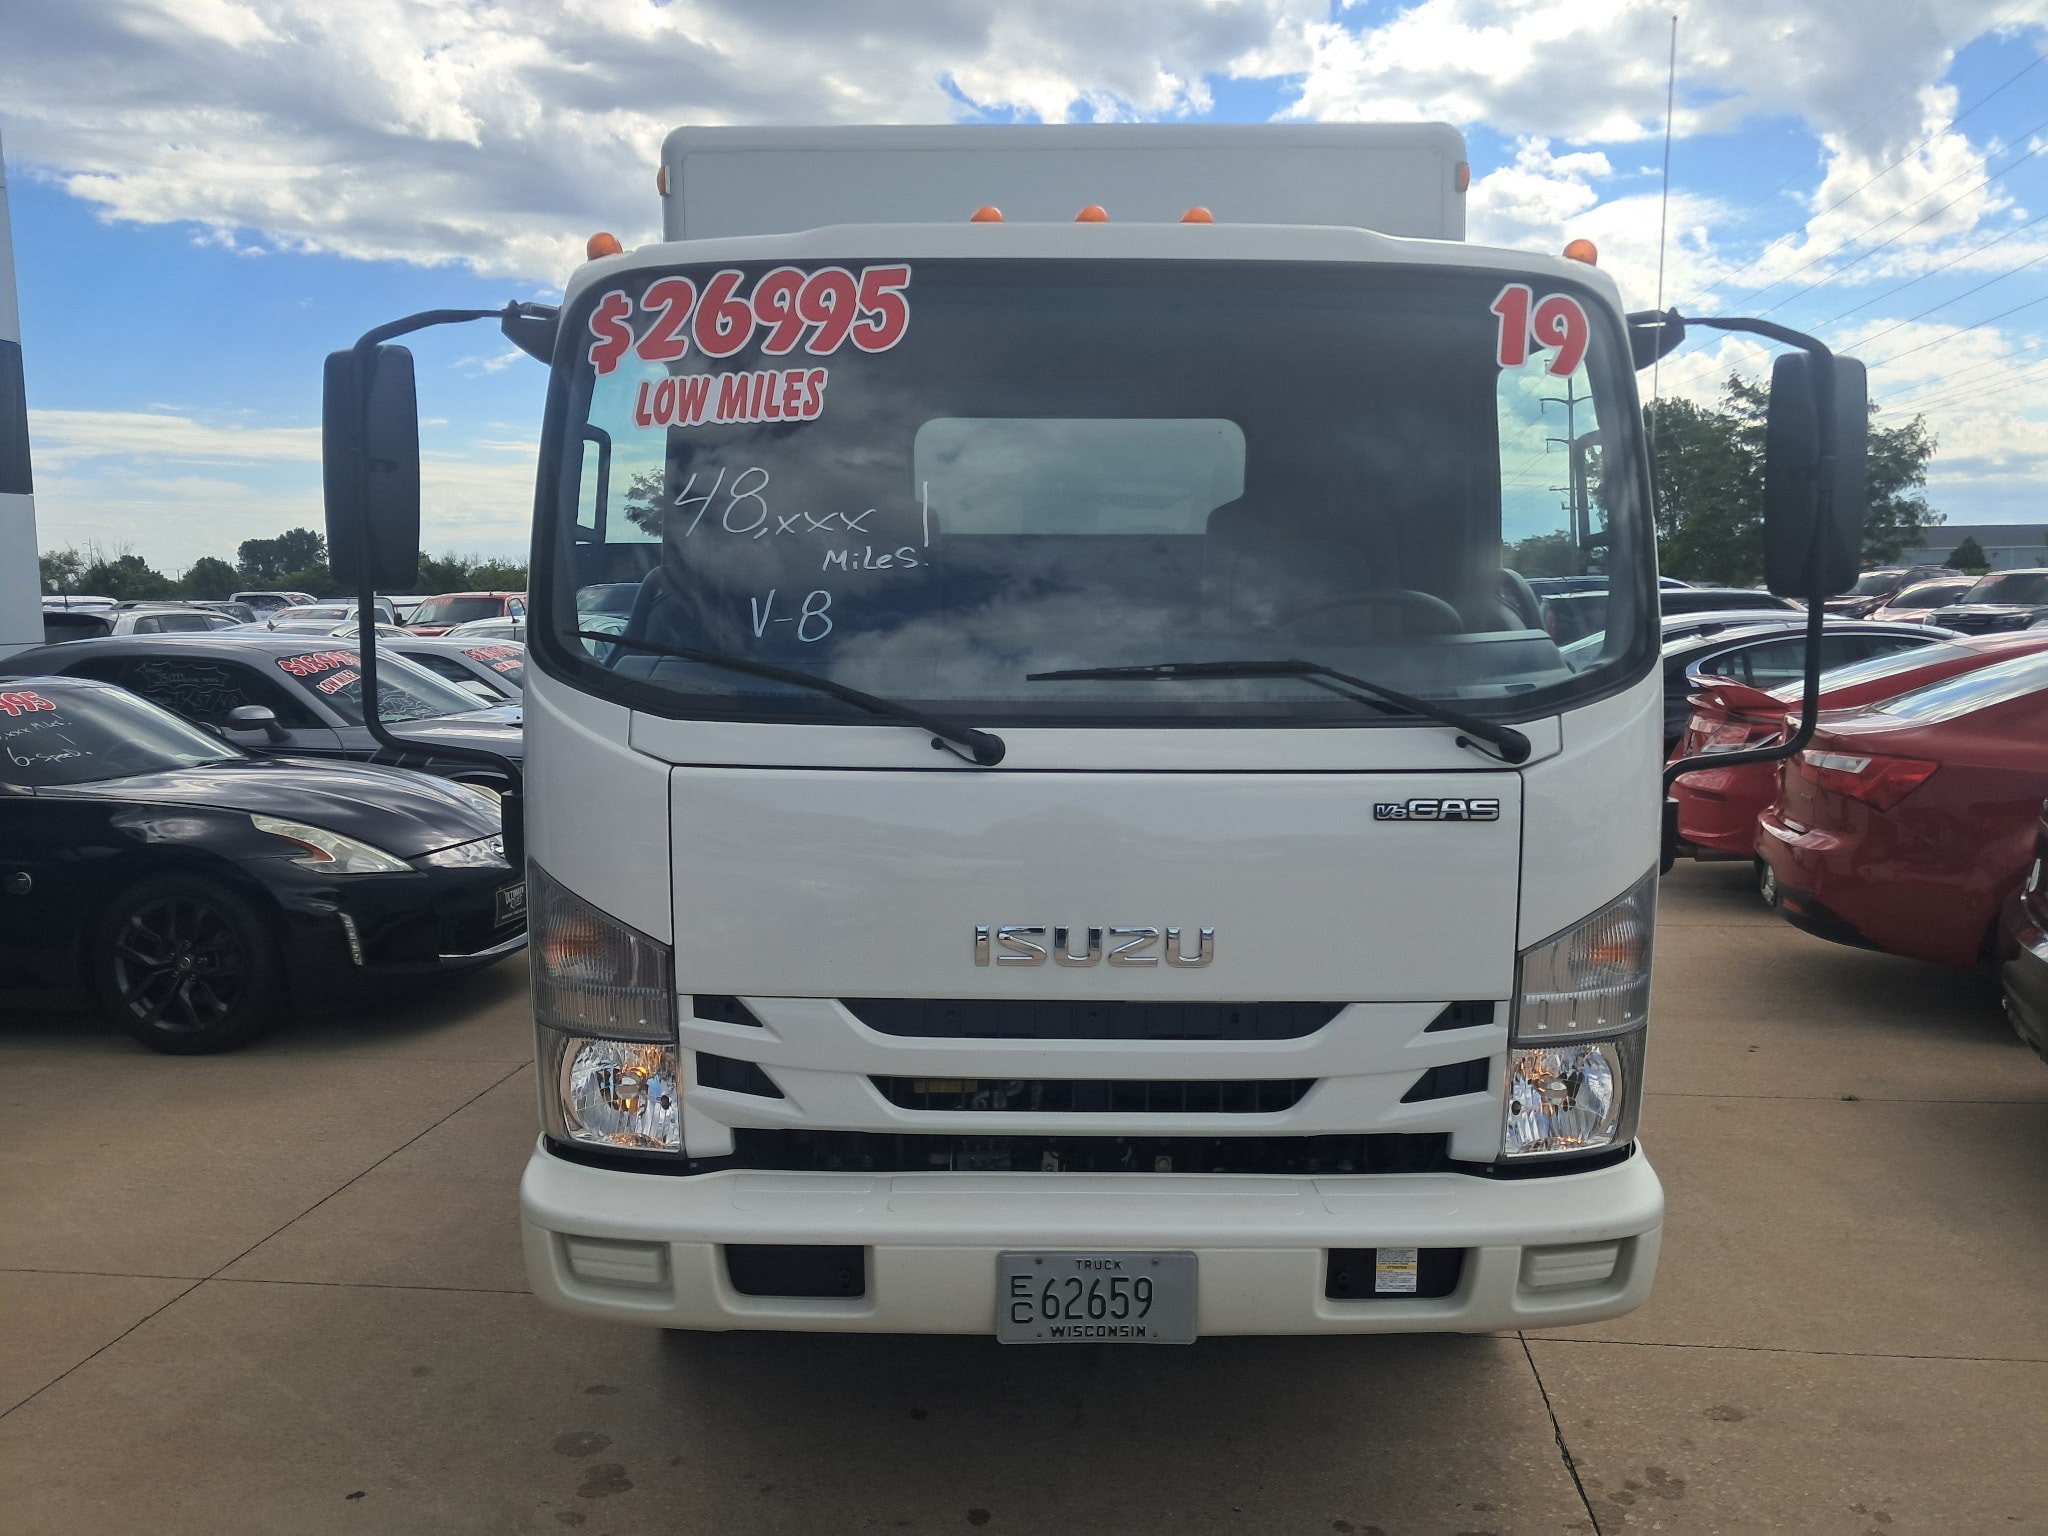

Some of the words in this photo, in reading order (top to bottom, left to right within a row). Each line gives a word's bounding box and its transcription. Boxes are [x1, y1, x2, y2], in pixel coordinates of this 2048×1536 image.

[588, 264, 911, 375] $26995
[1490, 283, 1590, 378] 19
[635, 375, 712, 428] LOW
[714, 367, 829, 424] MILES
[751, 589, 833, 642] V-8
[1407, 799, 1499, 820] GAS
[975, 925, 1214, 968] ISUZU
[1076, 1259, 1123, 1270] TRUCK
[1041, 1277, 1153, 1319] 62659
[1050, 1325, 1147, 1337] WISCONSIN
